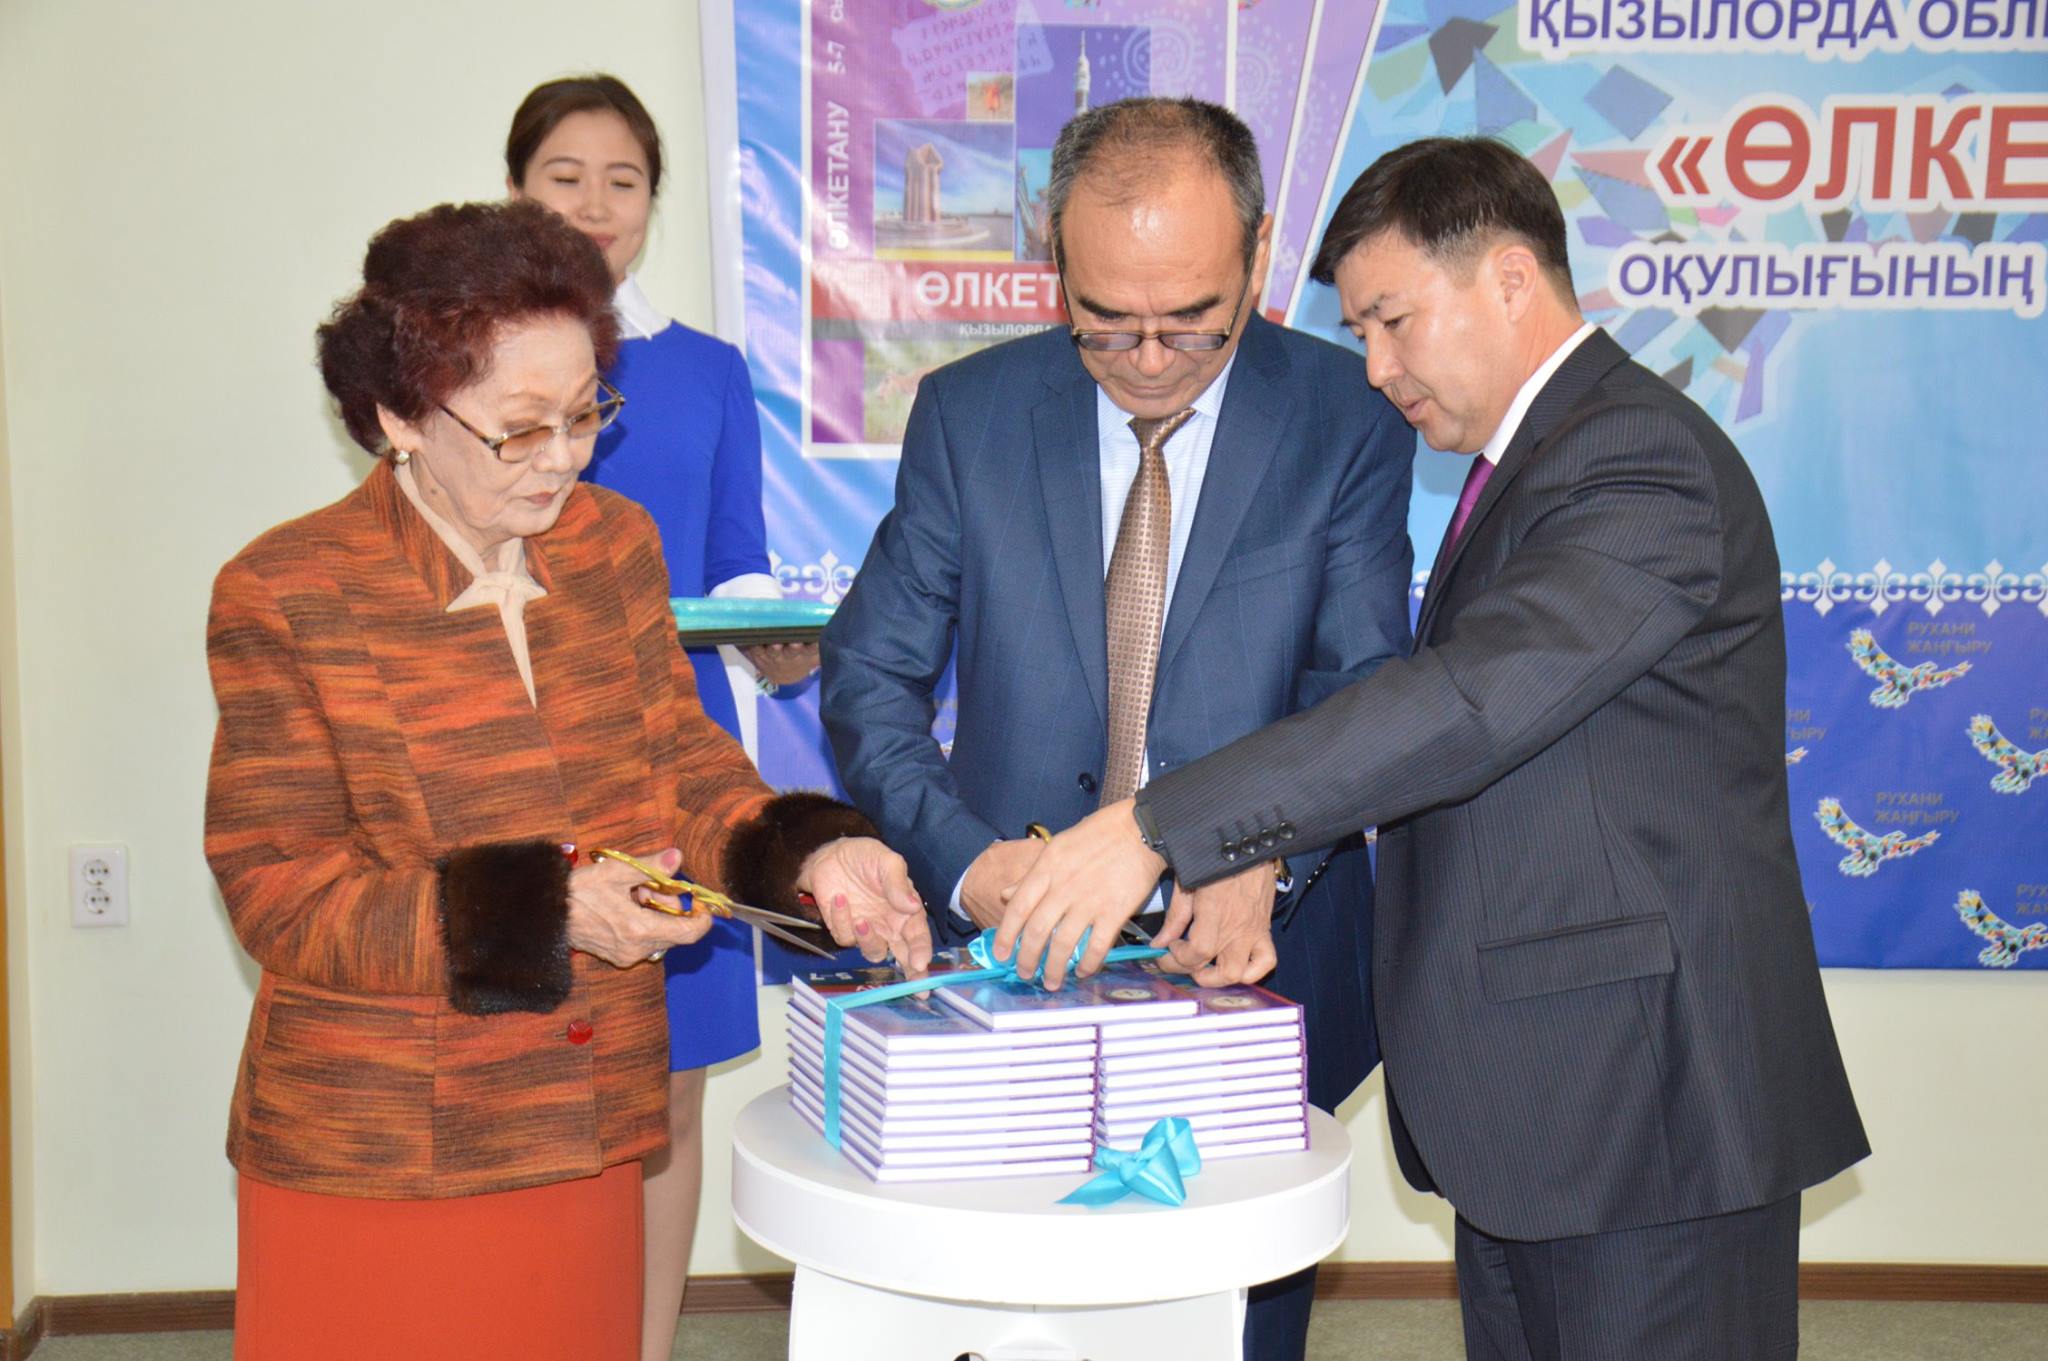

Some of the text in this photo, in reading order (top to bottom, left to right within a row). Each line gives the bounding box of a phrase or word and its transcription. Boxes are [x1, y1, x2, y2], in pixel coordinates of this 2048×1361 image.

[1530, 0, 2048, 48] ҚЫЗЫЛОРДА ОБЛ
[1656, 105, 2048, 200] «ӨЛКЕ
[917, 271, 1066, 308] ӨЛКЕТ
[1619, 255, 2034, 304] ОҚУЛЫҒЫНЫҢ
